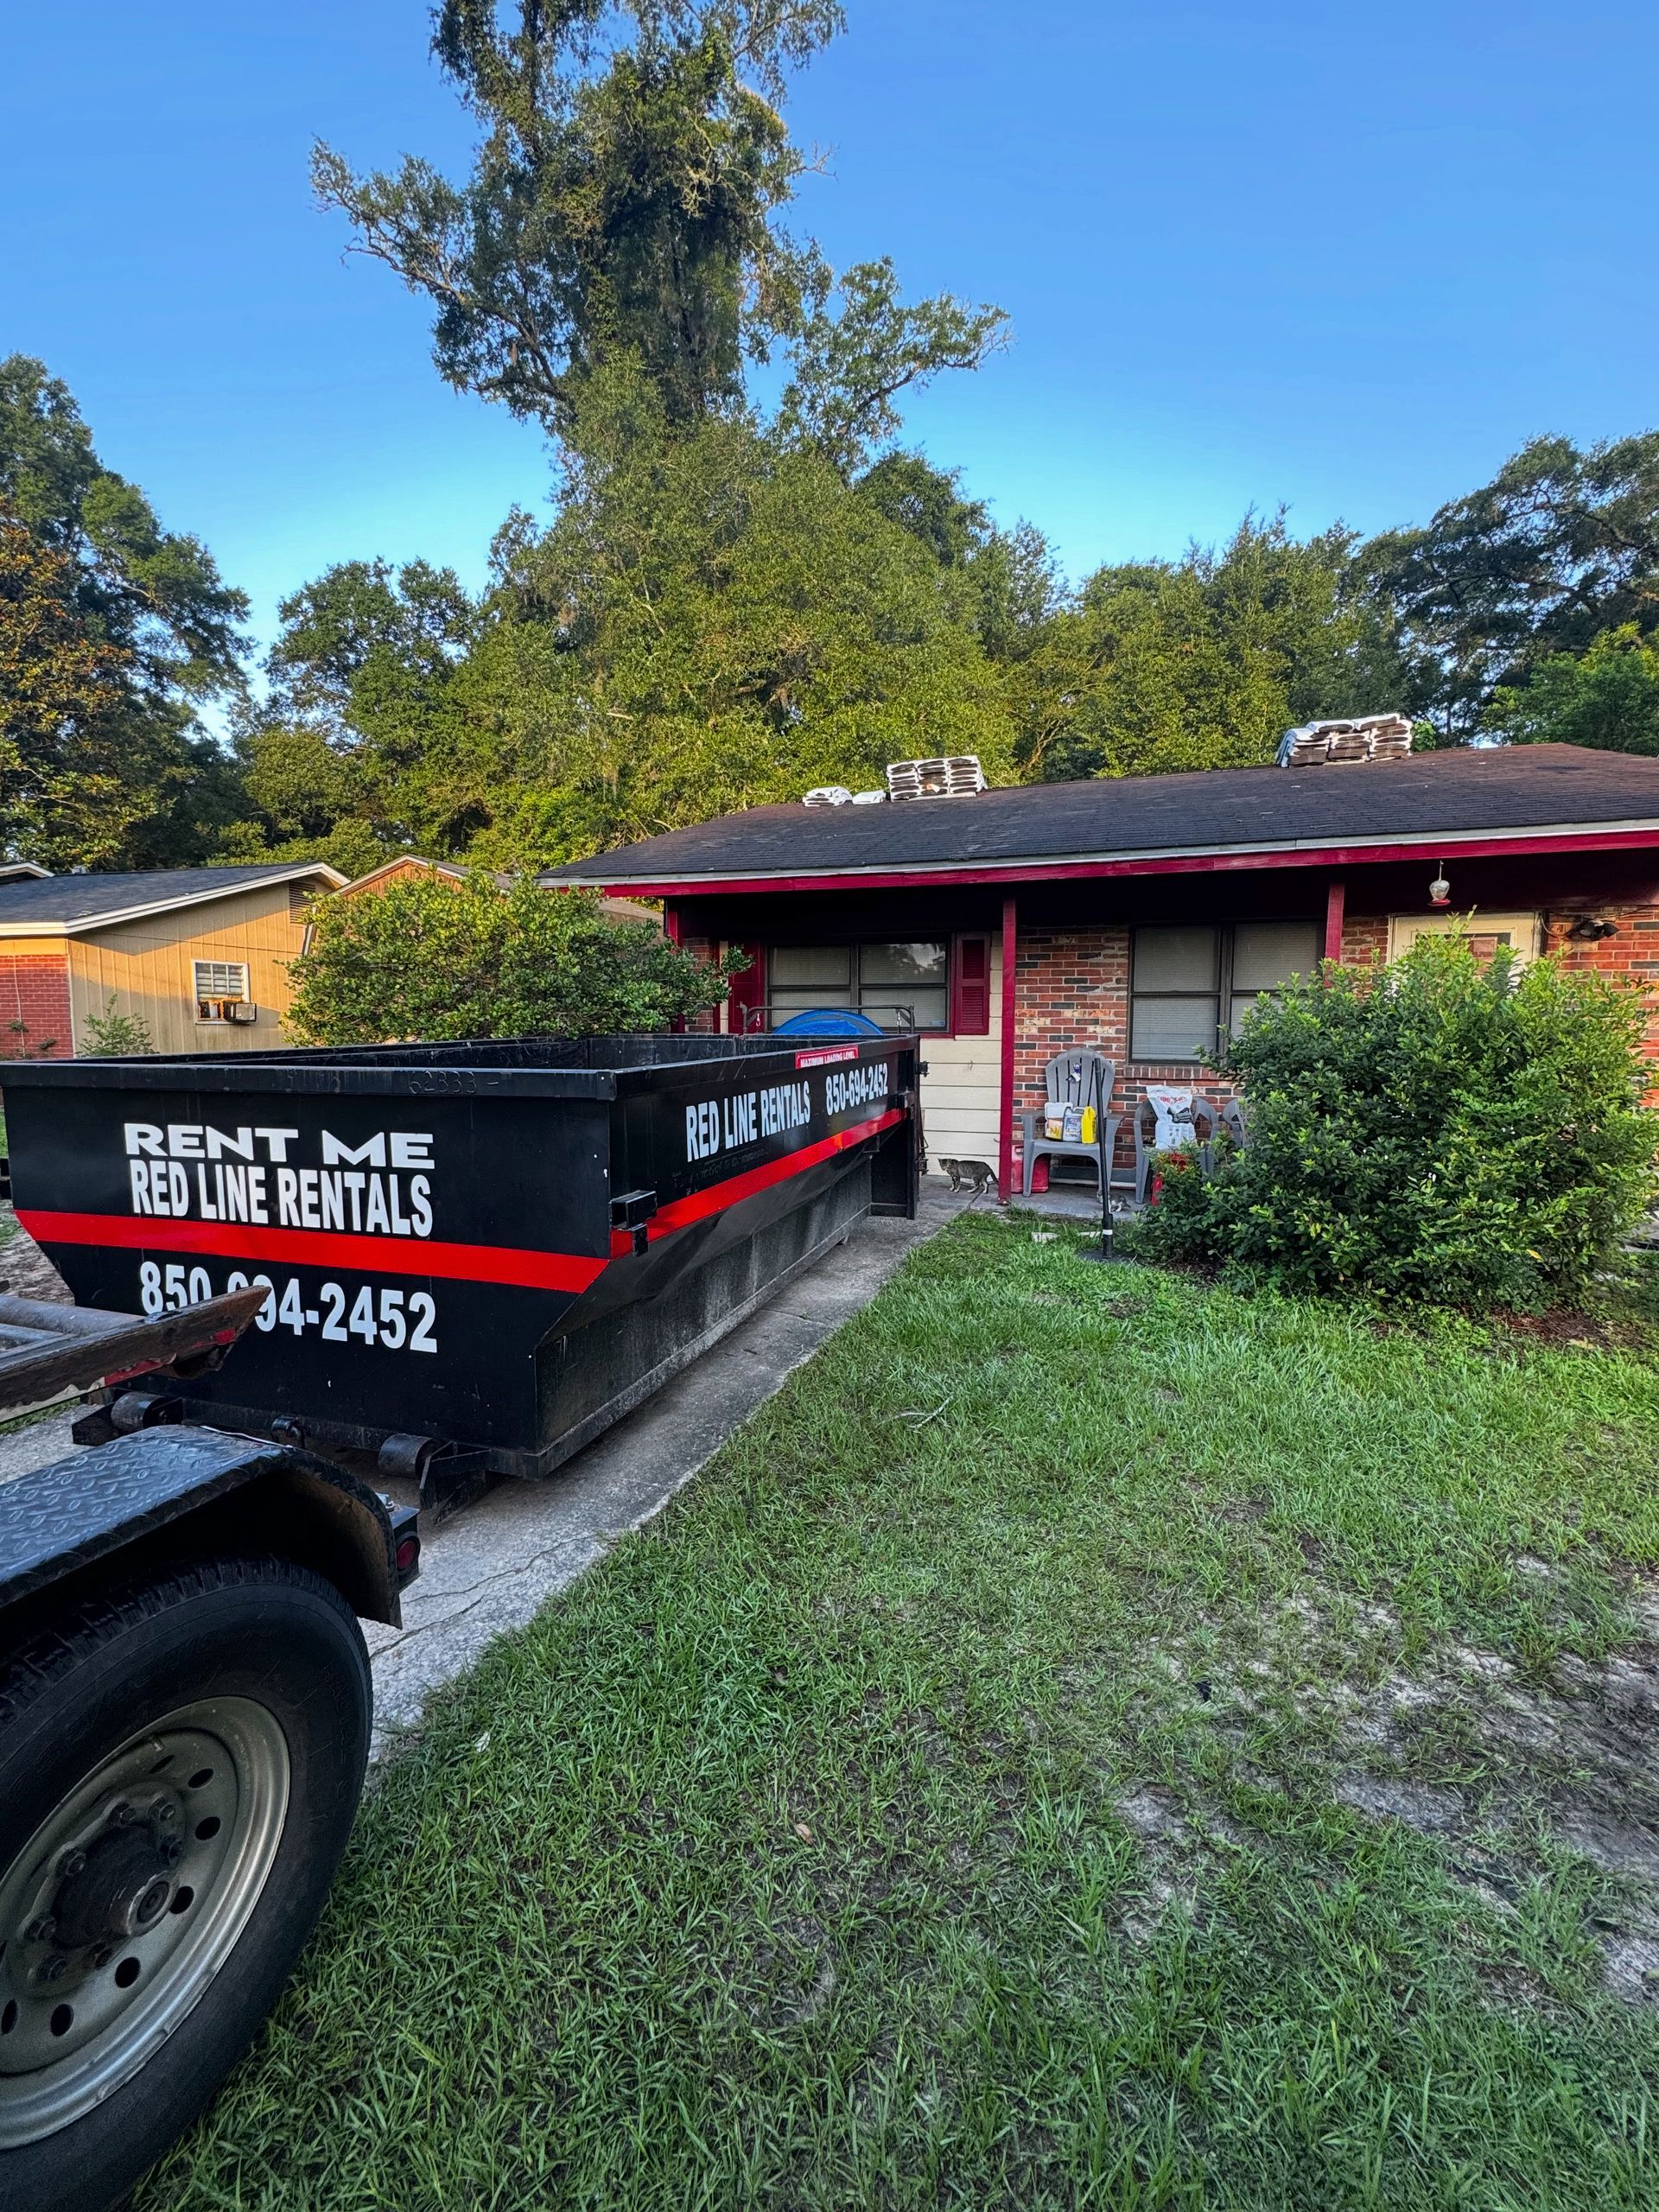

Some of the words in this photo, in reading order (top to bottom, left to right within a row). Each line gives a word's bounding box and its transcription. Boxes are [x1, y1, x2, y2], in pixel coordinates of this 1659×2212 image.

[124, 1122, 299, 1162] RENT
[322, 1129, 435, 1169] ME
[685, 1099, 720, 1162] RED
[724, 1091, 758, 1149] LINE
[760, 1080, 810, 1137] RENTALS
[825, 1062, 888, 1116] 850-694-2452
[130, 1159, 188, 1217] RED
[197, 1162, 269, 1224] LINE
[276, 1167, 433, 1237] RENTALS
[140, 1262, 437, 1353] 85094-2452
